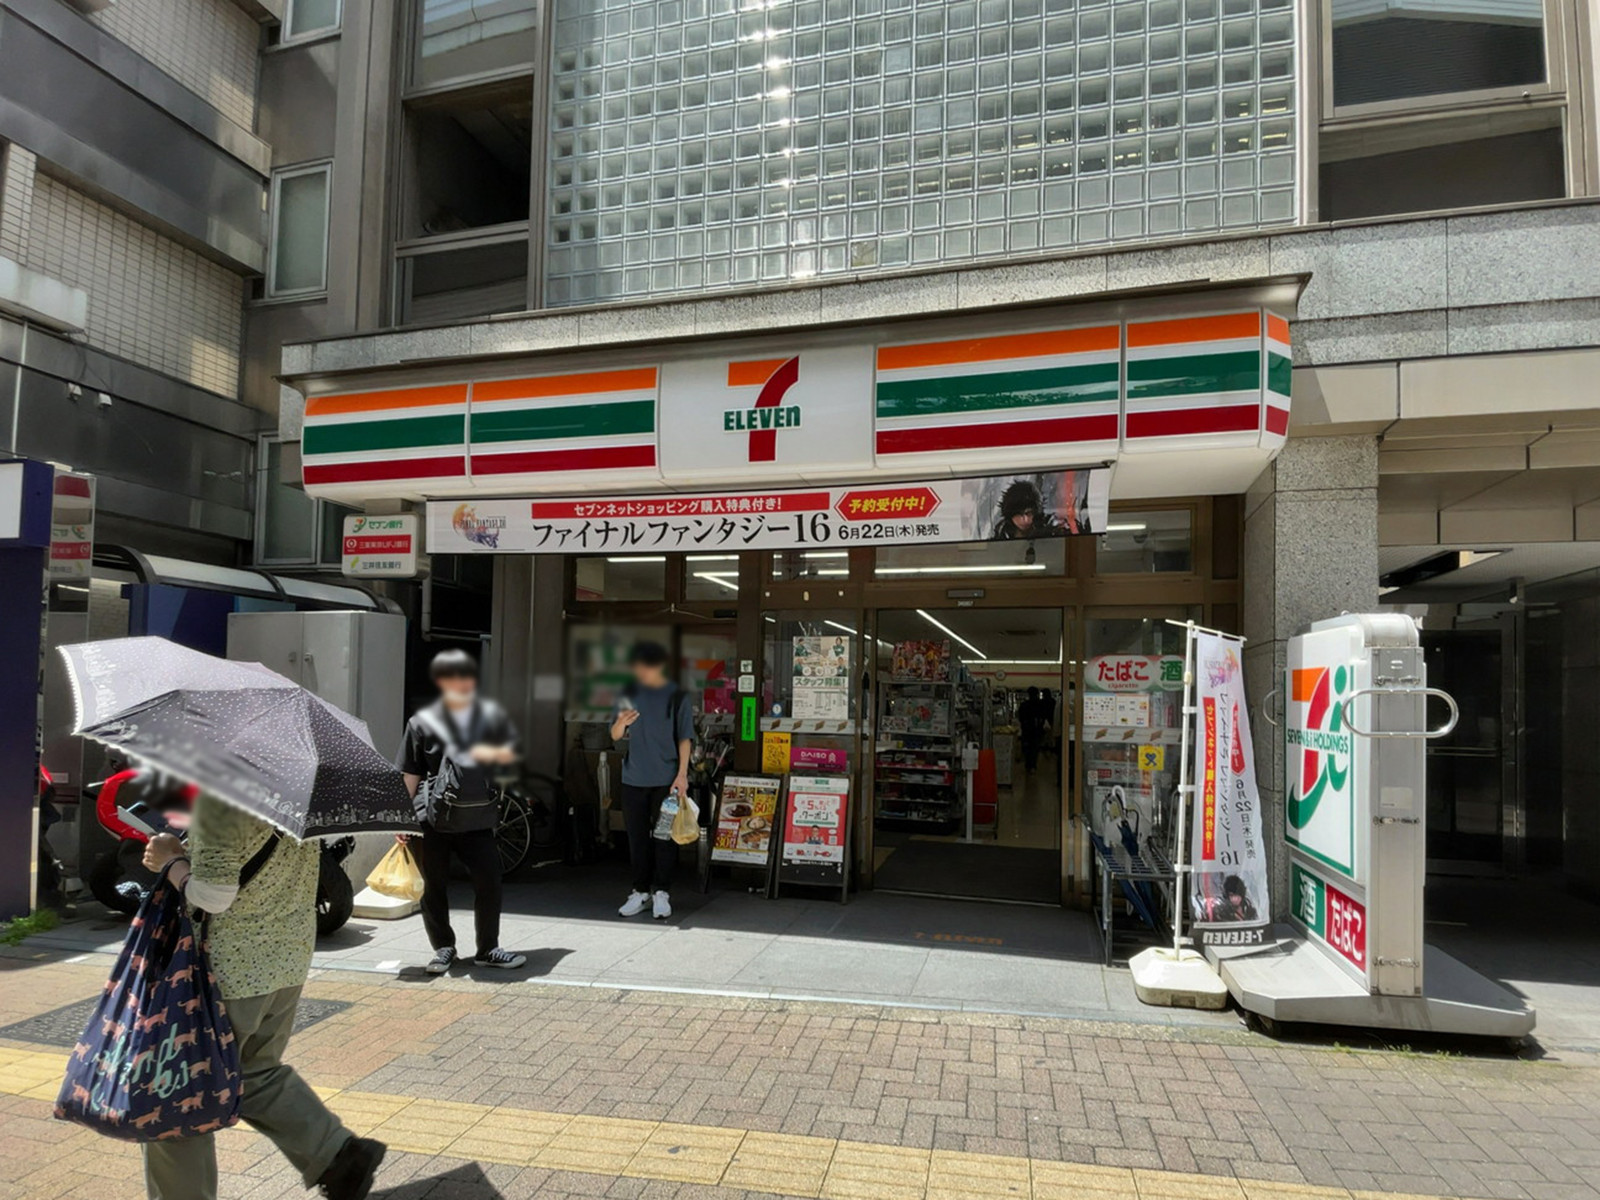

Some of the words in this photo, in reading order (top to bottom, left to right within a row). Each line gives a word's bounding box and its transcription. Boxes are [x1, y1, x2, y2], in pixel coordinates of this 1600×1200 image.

[574, 497, 782, 516] セブンネットショッピング購入特典付き!
[848, 496, 926, 514] 予約受付中!
[1098, 660, 1150, 682] たばこ
[1160, 660, 1183, 681] 酒
[1330, 893, 1363, 962] たばこ
